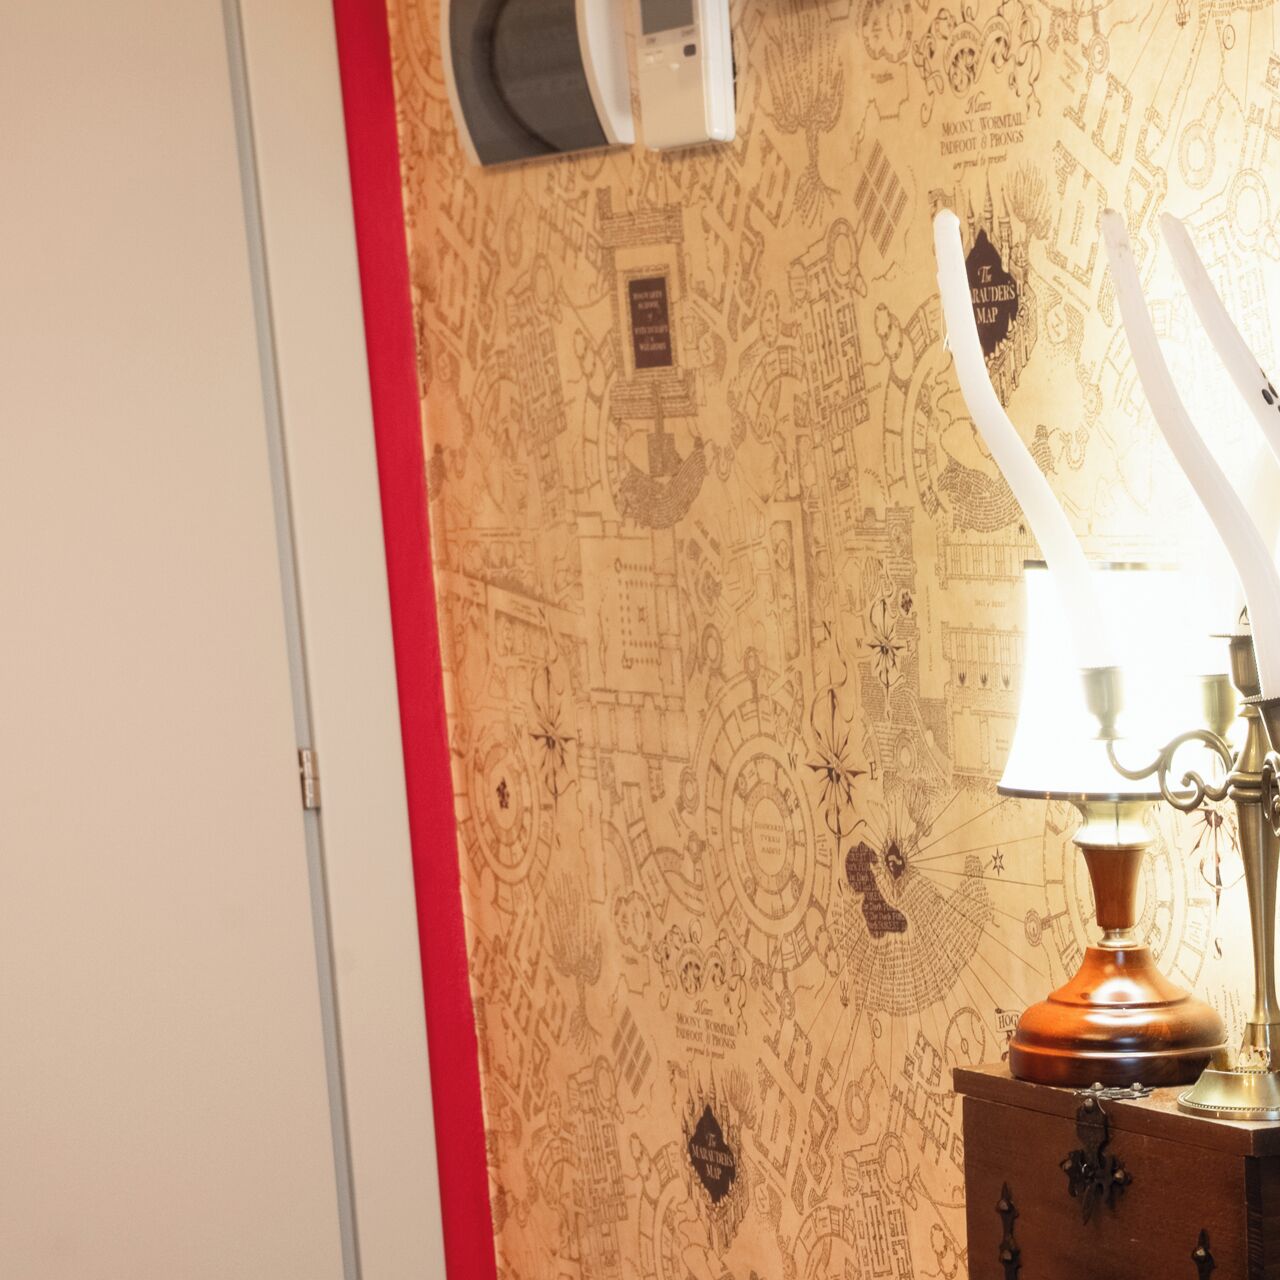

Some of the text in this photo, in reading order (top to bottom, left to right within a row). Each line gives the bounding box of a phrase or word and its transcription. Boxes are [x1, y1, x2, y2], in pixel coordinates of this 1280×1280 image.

[971, 280, 1016, 304] RAUDER'S
[976, 307, 998, 324] MAP
[869, 761, 879, 781] E
